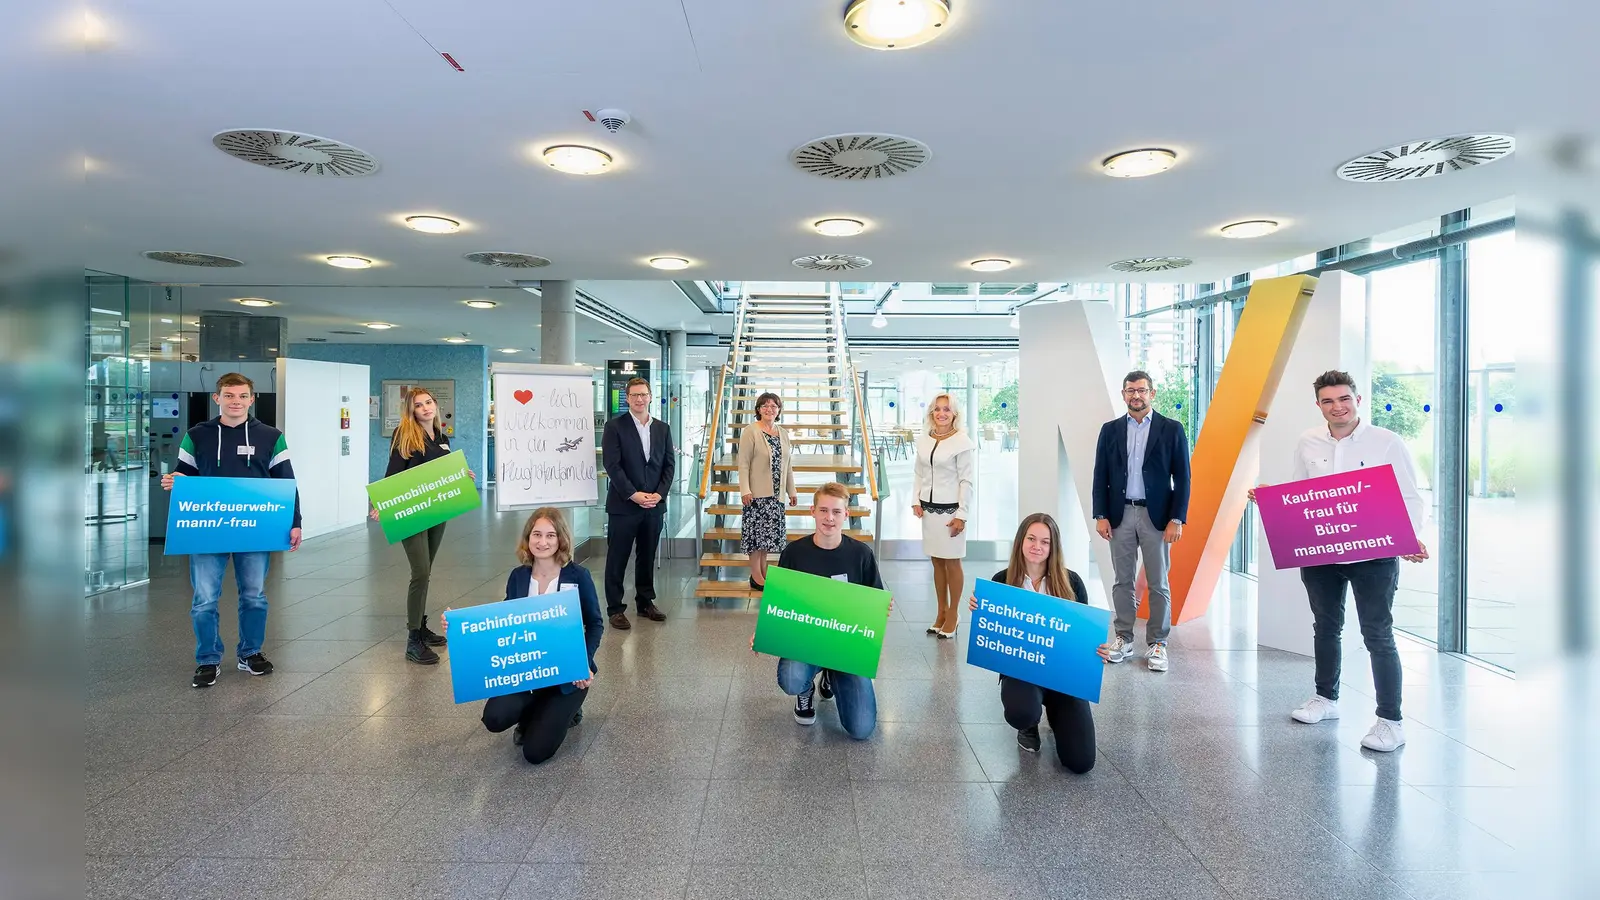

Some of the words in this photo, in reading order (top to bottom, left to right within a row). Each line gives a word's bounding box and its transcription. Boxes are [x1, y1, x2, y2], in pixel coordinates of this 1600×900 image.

[504, 437, 520, 452] in
[527, 435, 547, 453] der
[376, 467, 467, 511] Immobilienkauf
[1281, 481, 1371, 505] Kaufmann/-
[178, 500, 286, 512] Werkfeuerwehr-
[393, 487, 461, 520] mann/-frau
[1303, 507, 1334, 520] frau
[1336, 502, 1359, 515] für
[176, 517, 257, 528] mann/-frau
[1314, 523, 1358, 536] Büro-
[1294, 534, 1395, 557] management
[461, 605, 568, 635] Fachinformatik
[766, 604, 876, 639] Mechatroniker/-in
[980, 598, 1047, 627] Fachkraft
[1049, 617, 1072, 633] für
[497, 630, 537, 648] er/-in
[978, 617, 1025, 640] Schutz
[1027, 634, 1055, 649] und
[490, 649, 548, 670] System-
[976, 634, 1046, 666] Sicherheit
[484, 665, 560, 689] integration
